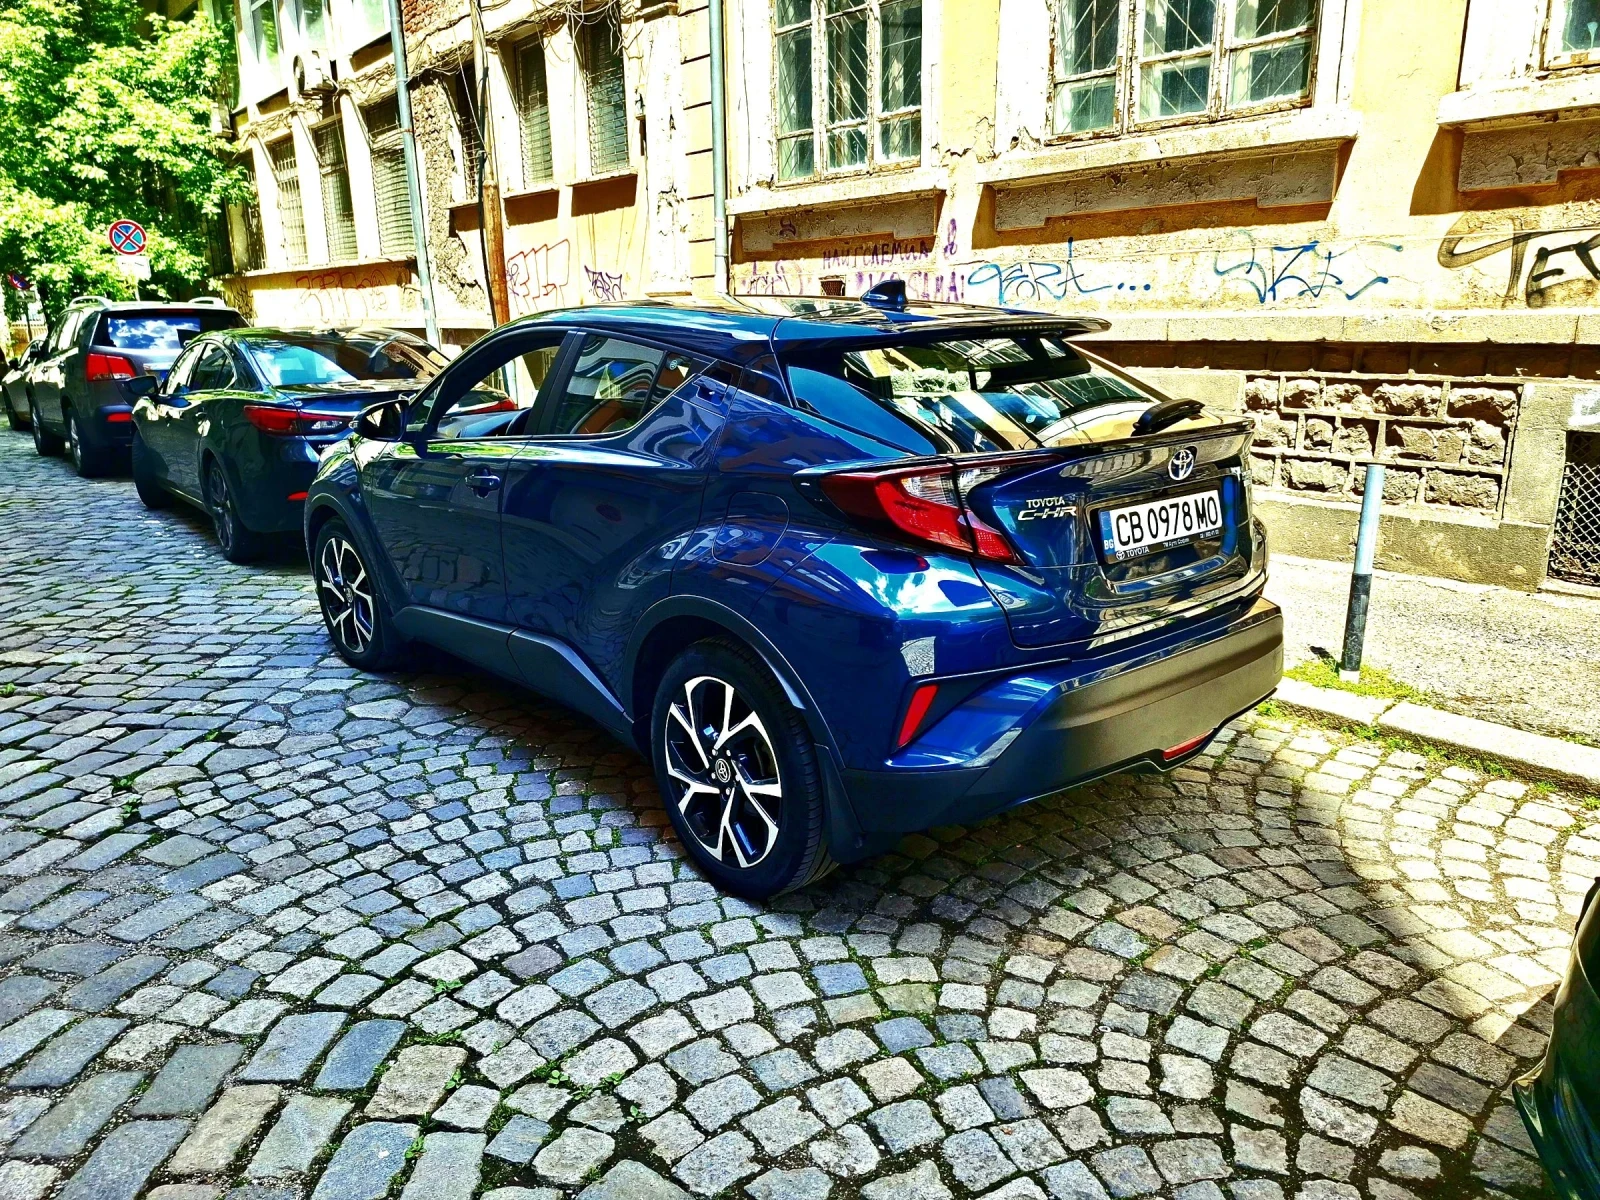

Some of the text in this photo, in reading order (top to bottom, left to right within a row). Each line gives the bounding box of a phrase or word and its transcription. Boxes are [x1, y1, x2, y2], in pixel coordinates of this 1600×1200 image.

[1026, 496, 1066, 508] TOYOTA
[1017, 506, 1077, 521] C-HR
[1115, 495, 1220, 547] CB 0978 MO
[1103, 538, 1114, 550] BG
[1126, 546, 1150, 558] TOYOTA
